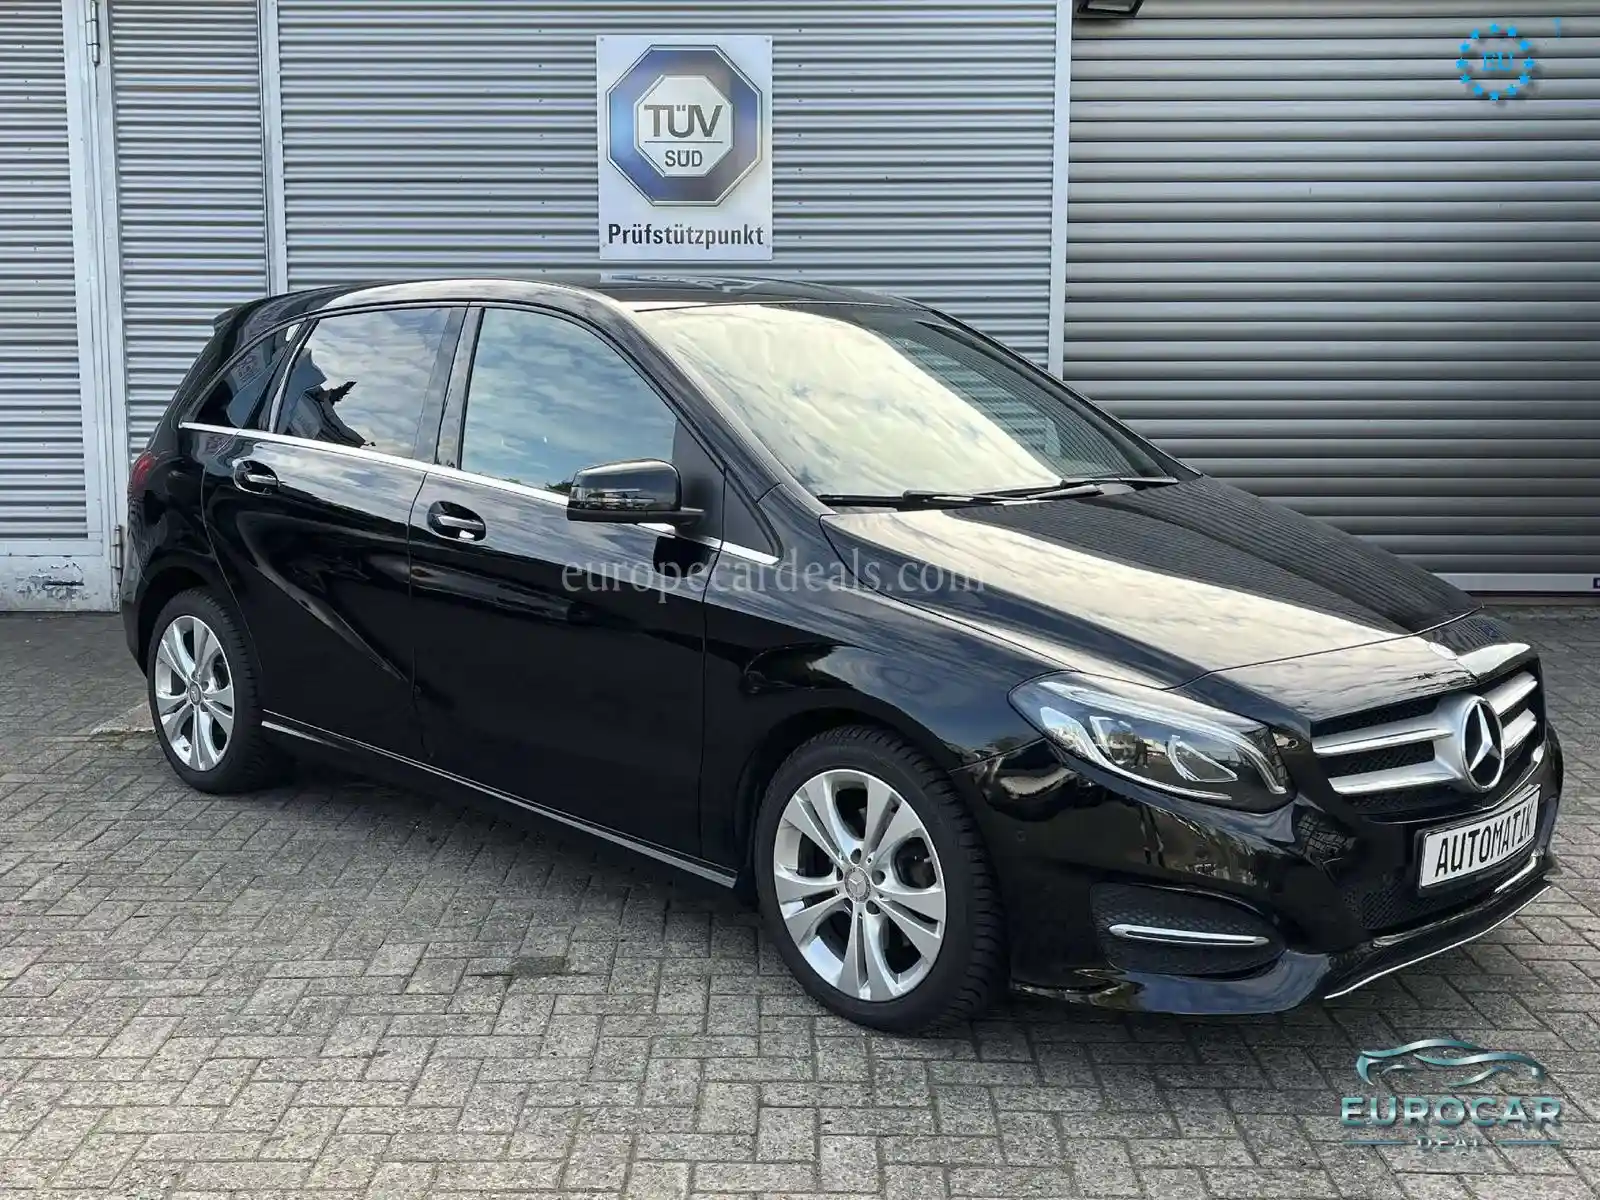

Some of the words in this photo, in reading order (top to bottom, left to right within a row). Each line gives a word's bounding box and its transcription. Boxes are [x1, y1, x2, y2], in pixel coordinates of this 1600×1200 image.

[644, 104, 723, 138] TÜV
[664, 149, 703, 167] SÜD
[608, 223, 764, 250] Prüfstützpunkt
[1435, 803, 1534, 877] AUTOMATIK
